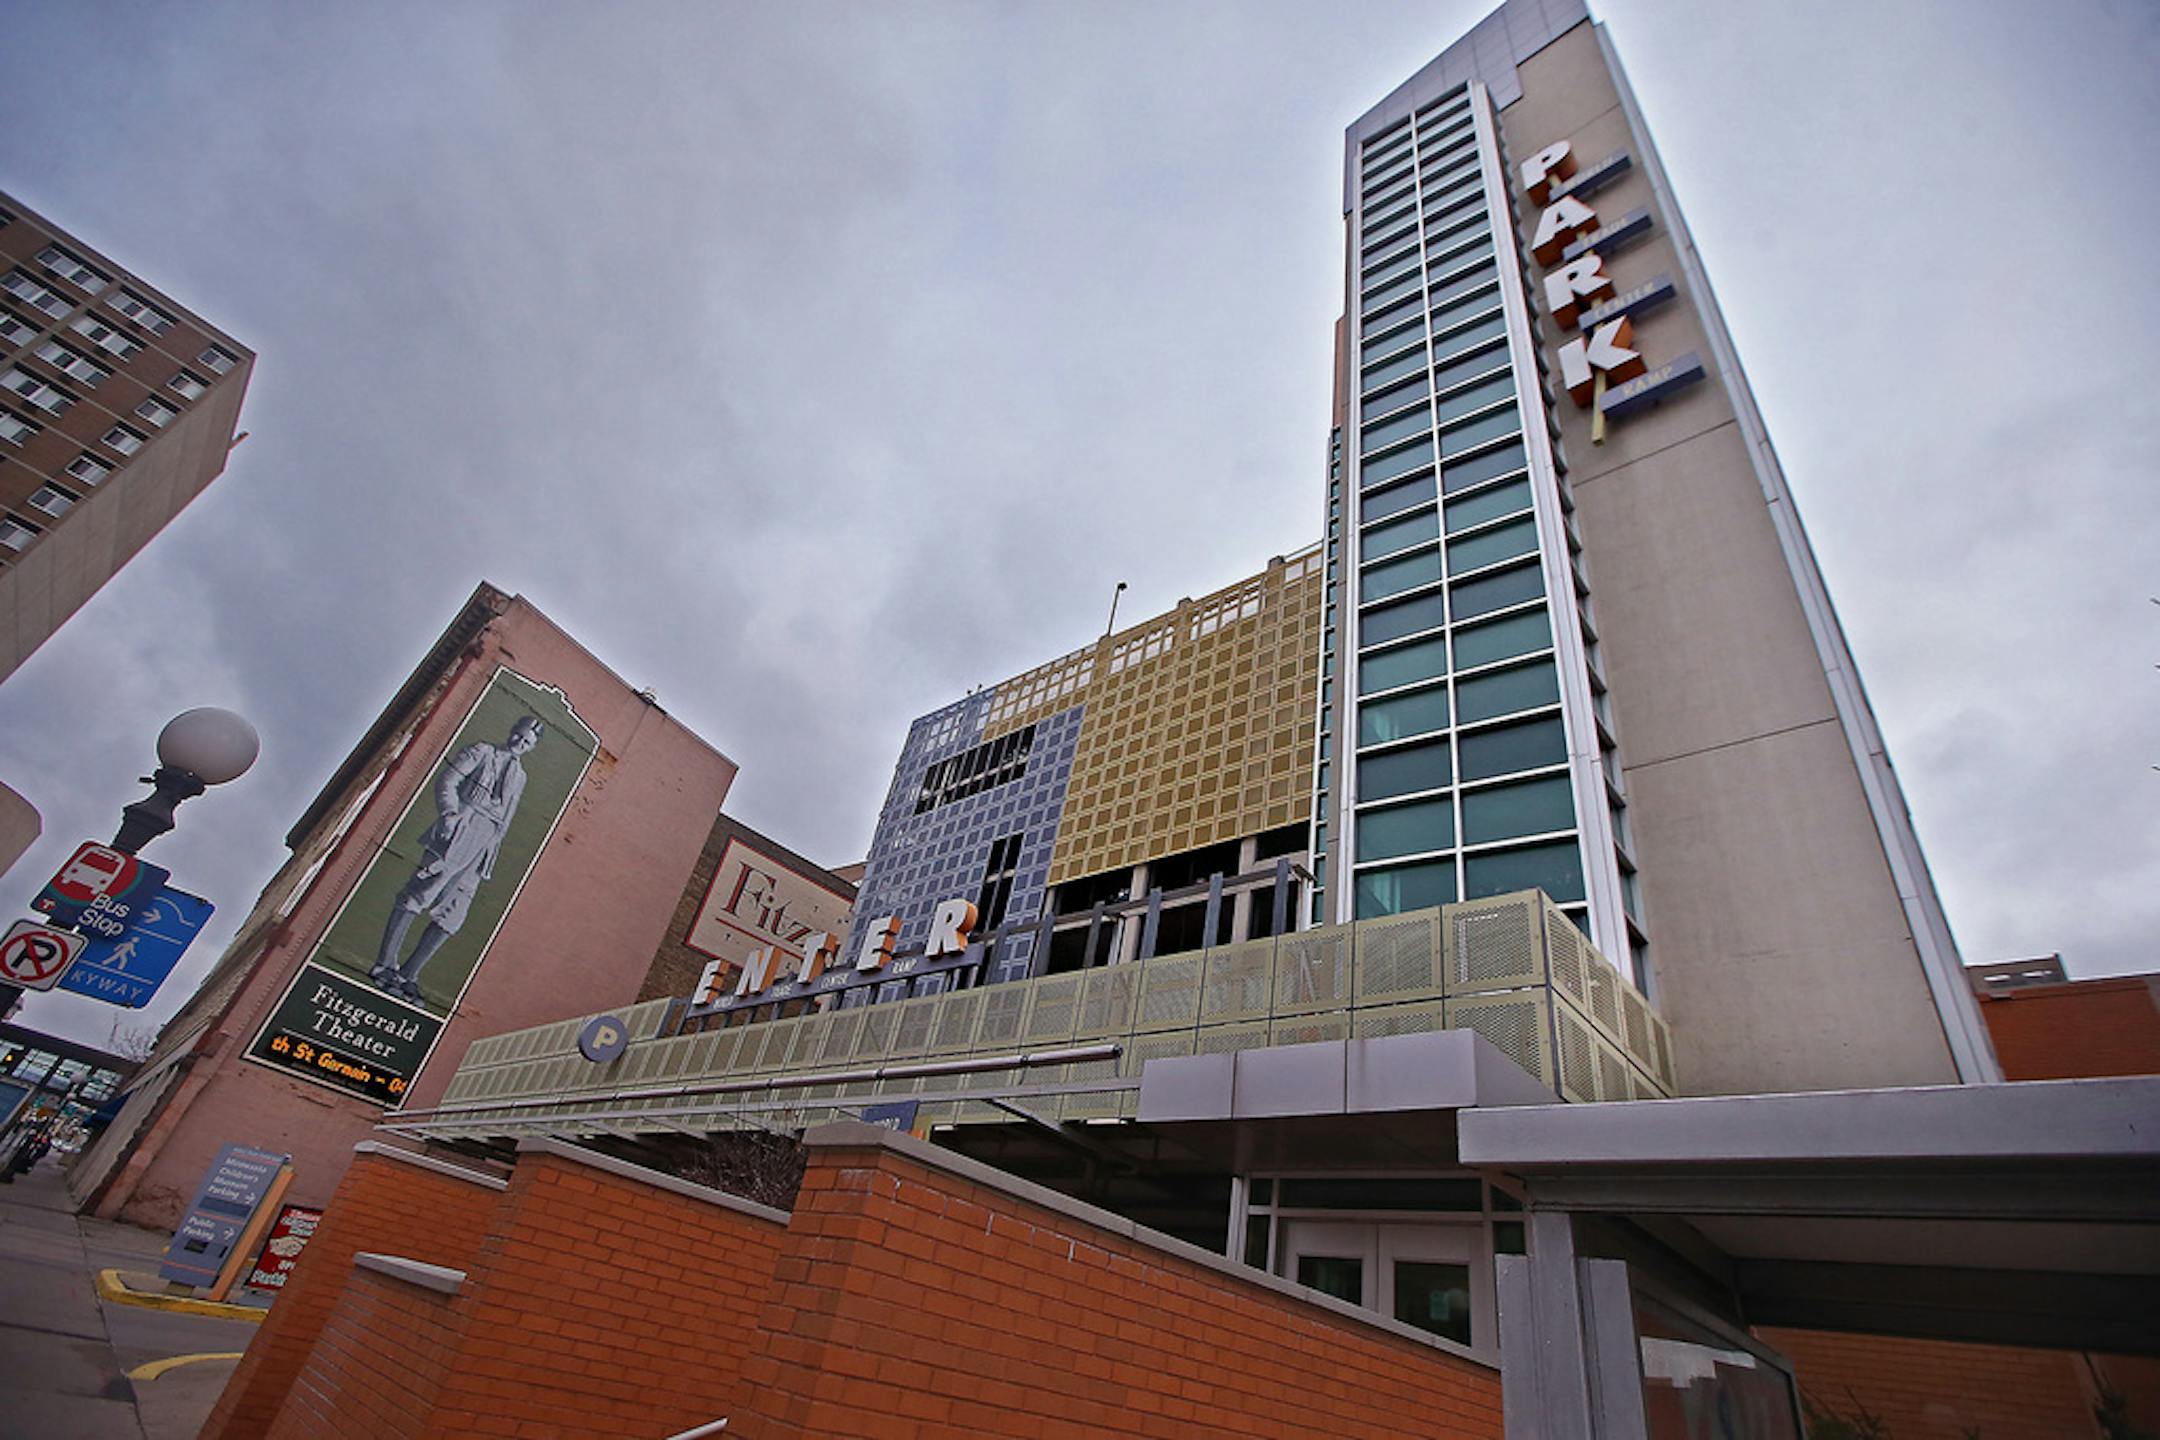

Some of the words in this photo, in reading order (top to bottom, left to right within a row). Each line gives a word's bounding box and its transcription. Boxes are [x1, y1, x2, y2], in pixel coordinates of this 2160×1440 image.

[1520, 140, 1647, 405] PARK
[1623, 365, 1673, 397] RAMP
[90, 892, 131, 918] Bus
[79, 907, 124, 937] Stop
[692, 898, 978, 1006] ENTER
[70, 969, 144, 1000] KYWAY
[309, 983, 420, 1043] Fitzgerald
[311, 1009, 397, 1060] Theater
[592, 1024, 618, 1051] P
[293, 1042, 316, 1063] St
[207, 1185, 241, 1200] Parking
[182, 1225, 216, 1241] Parking
